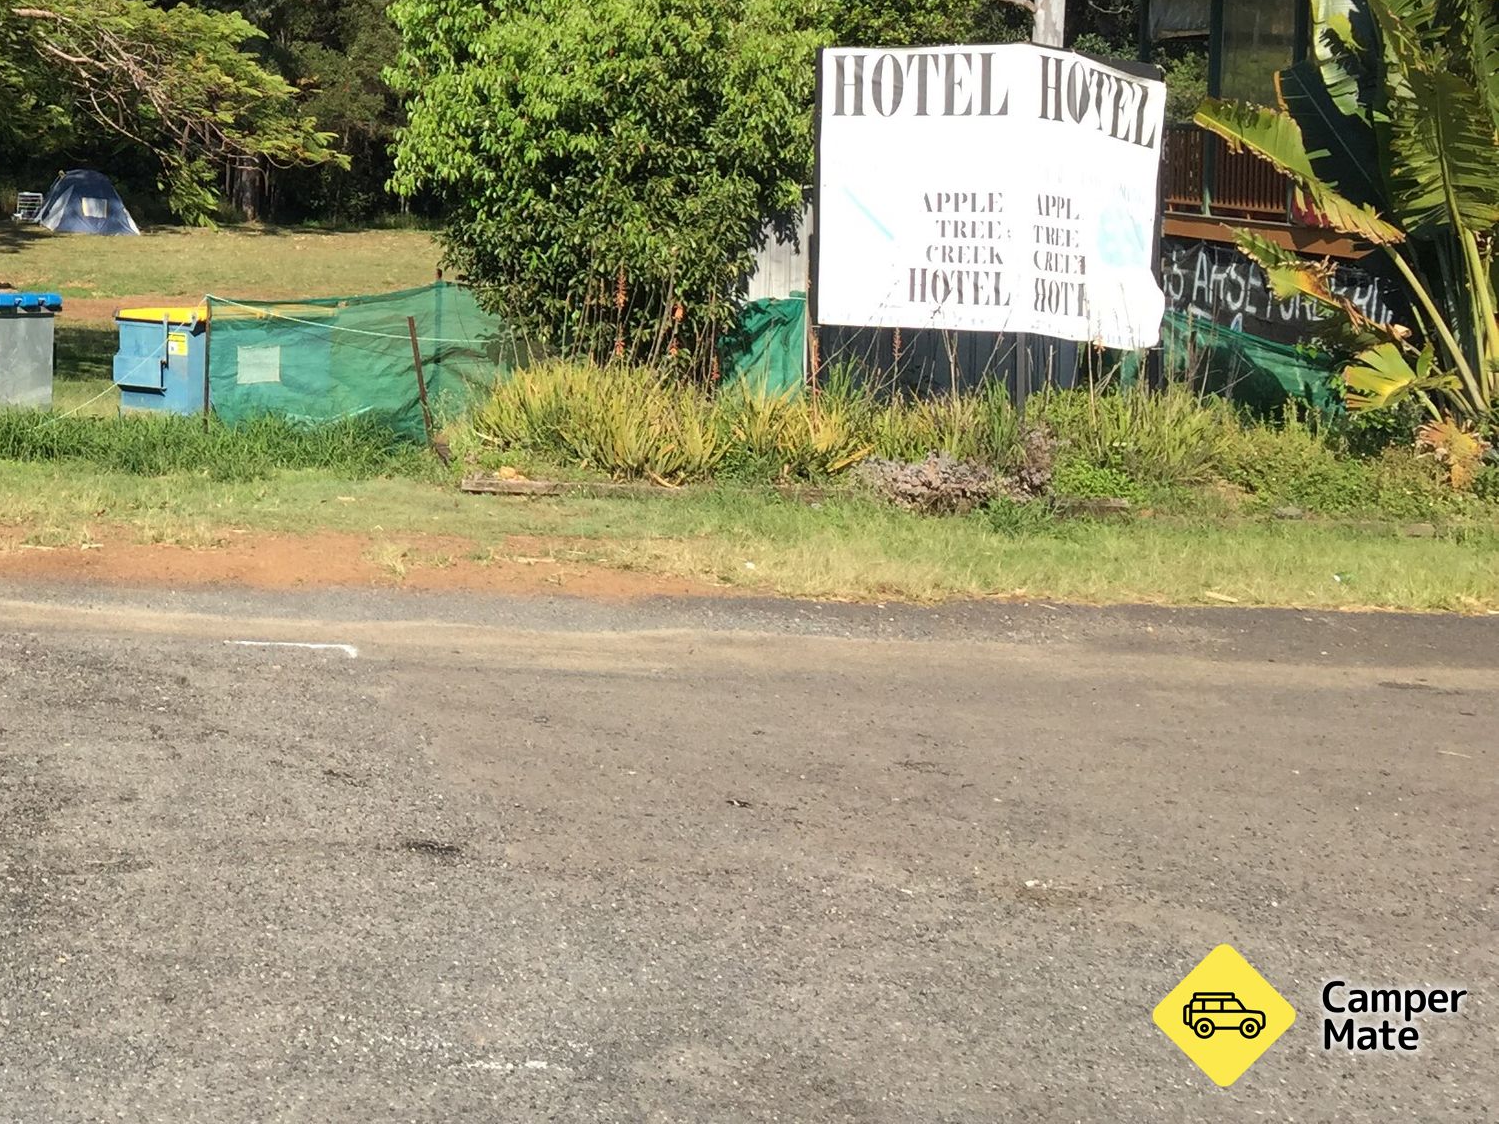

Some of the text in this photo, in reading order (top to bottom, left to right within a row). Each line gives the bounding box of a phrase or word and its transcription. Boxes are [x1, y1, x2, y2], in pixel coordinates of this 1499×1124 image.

[832, 52, 1009, 117] HOTEL
[1038, 54, 1155, 149] HOTEL
[920, 192, 1004, 213] APPLE
[935, 219, 1002, 240] TREE
[925, 244, 1004, 265] CREEK
[907, 267, 1011, 307] HOTEL
